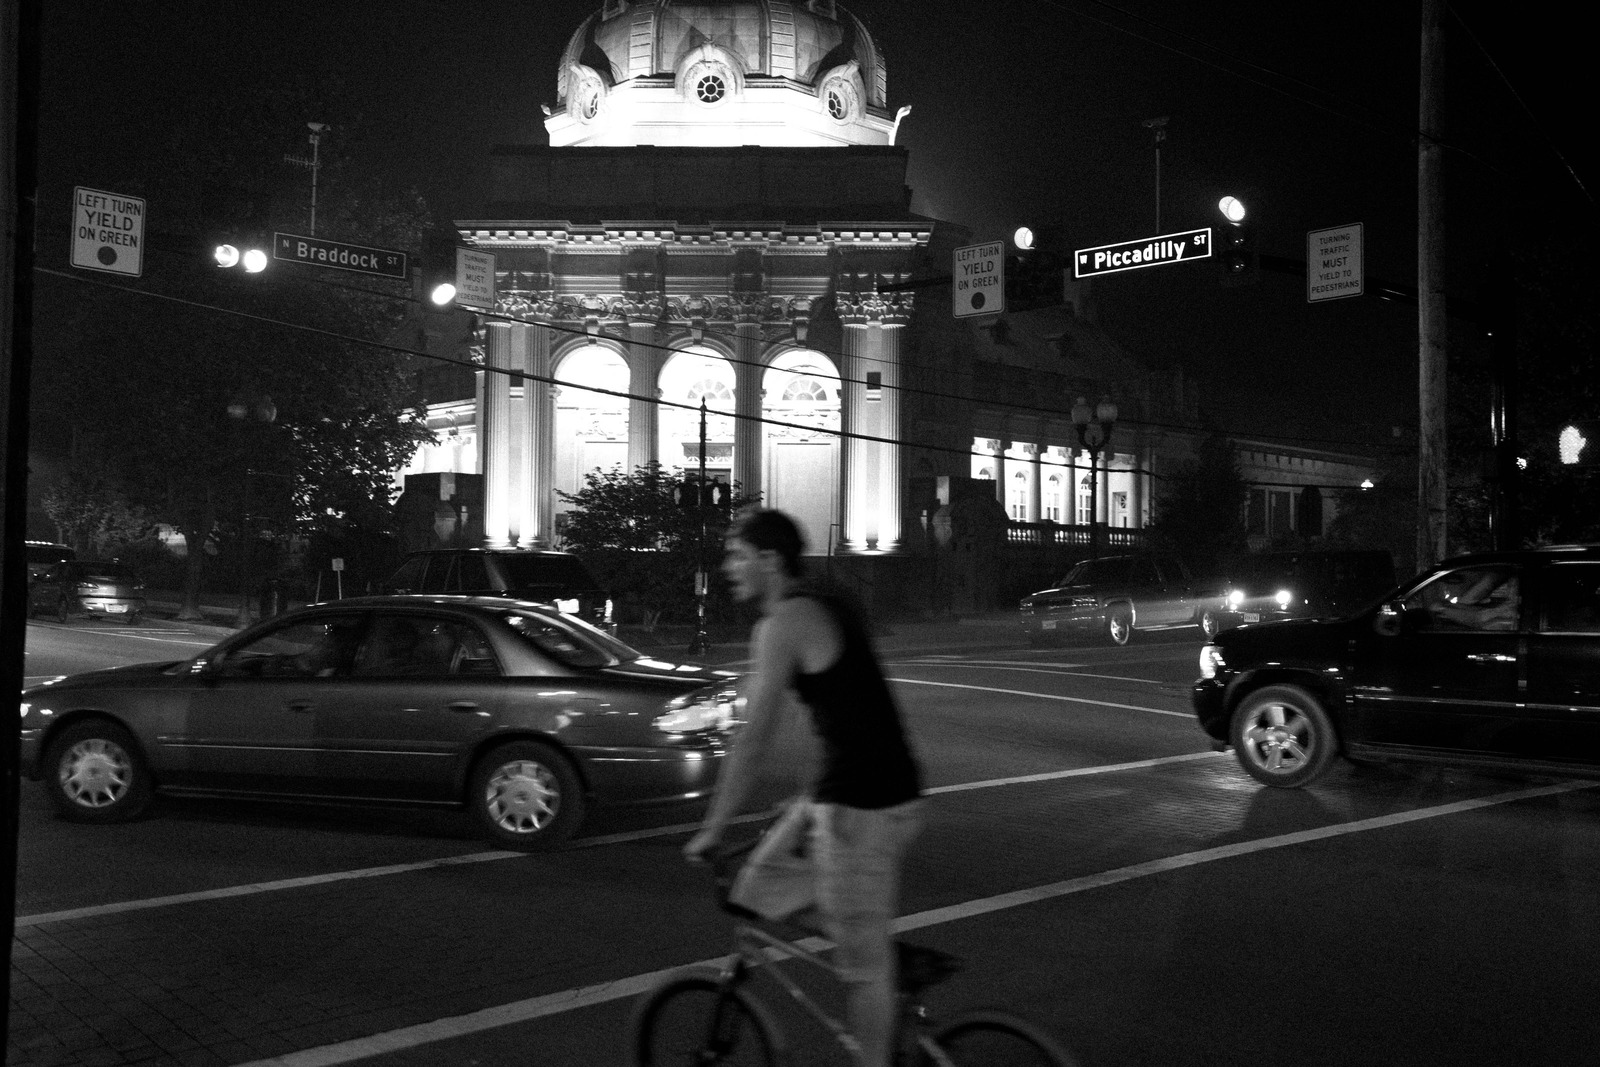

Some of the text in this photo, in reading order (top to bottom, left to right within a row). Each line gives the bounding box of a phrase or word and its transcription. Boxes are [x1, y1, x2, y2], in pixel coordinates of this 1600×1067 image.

[79, 193, 141, 216] LEFT TURN
[85, 209, 133, 231] YIELD
[79, 226, 137, 247] ON GREEN
[1319, 233, 1350, 244] TURNING
[283, 240, 397, 269] N Braddock ST
[957, 245, 999, 261] LEFT TURN
[1094, 240, 1185, 269] Piccadilly
[1193, 234, 1206, 245] ST
[1320, 245, 1349, 255] TRAFFIC
[963, 260, 994, 275] YIELD
[1323, 257, 1347, 269] MUST
[466, 273, 484, 283] MUST
[958, 275, 998, 290] ON GREEN
[1319, 269, 1352, 281] YIELD TO
[1312, 280, 1359, 293] PEDESTRIANS
